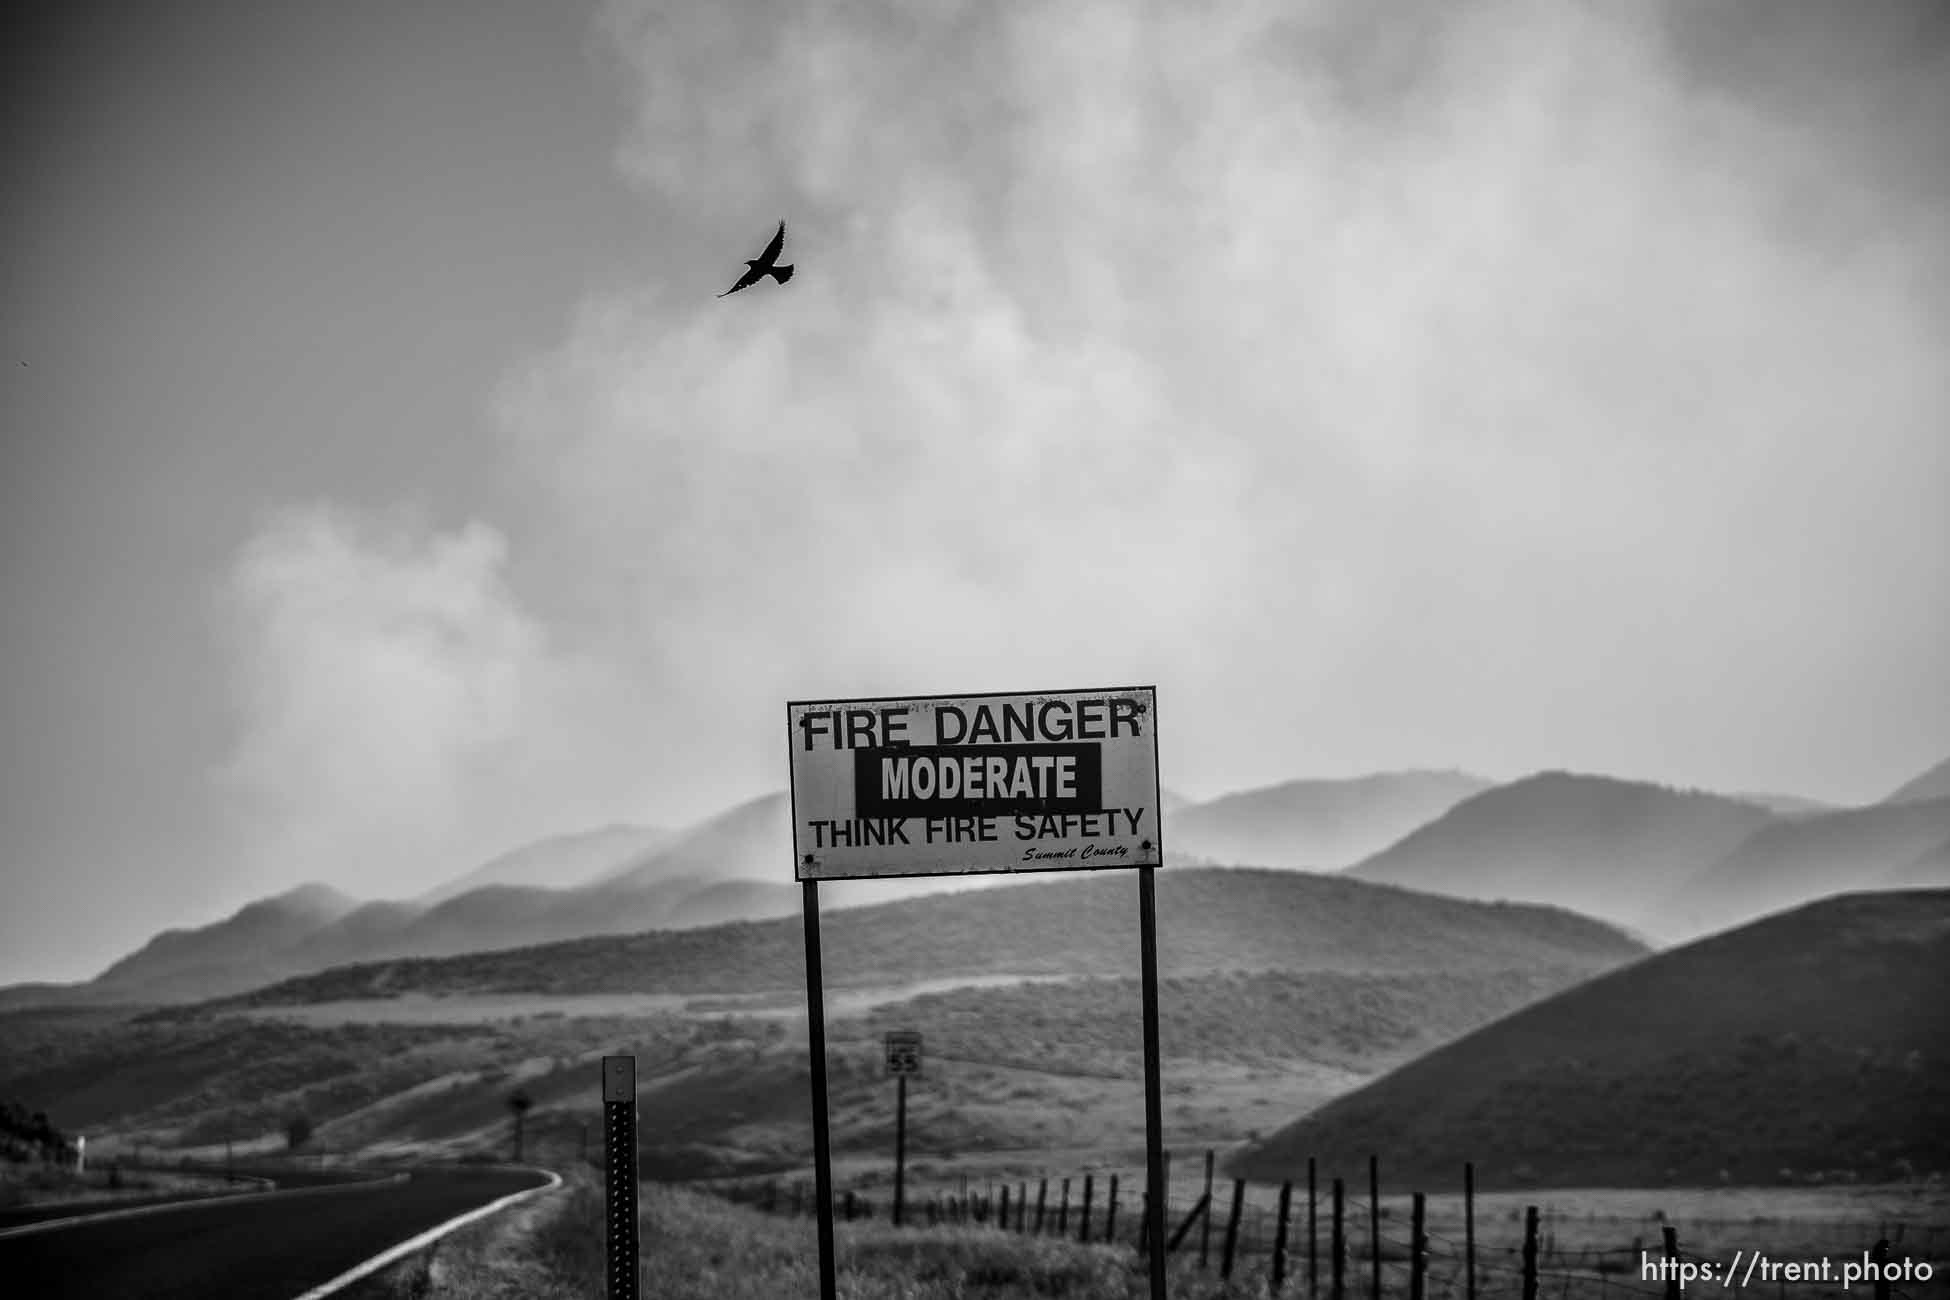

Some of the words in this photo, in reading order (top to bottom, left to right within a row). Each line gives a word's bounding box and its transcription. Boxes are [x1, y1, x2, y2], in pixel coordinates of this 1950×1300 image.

[804, 708, 911, 751] FIRE
[935, 699, 1141, 744] DANGER
[882, 756, 1077, 799] MODERATE
[808, 818, 910, 848] THINK
[926, 816, 998, 844] FIRE
[1015, 808, 1144, 840] SAFETY
[1022, 848, 1078, 861] Summit
[1081, 844, 1129, 861] County
